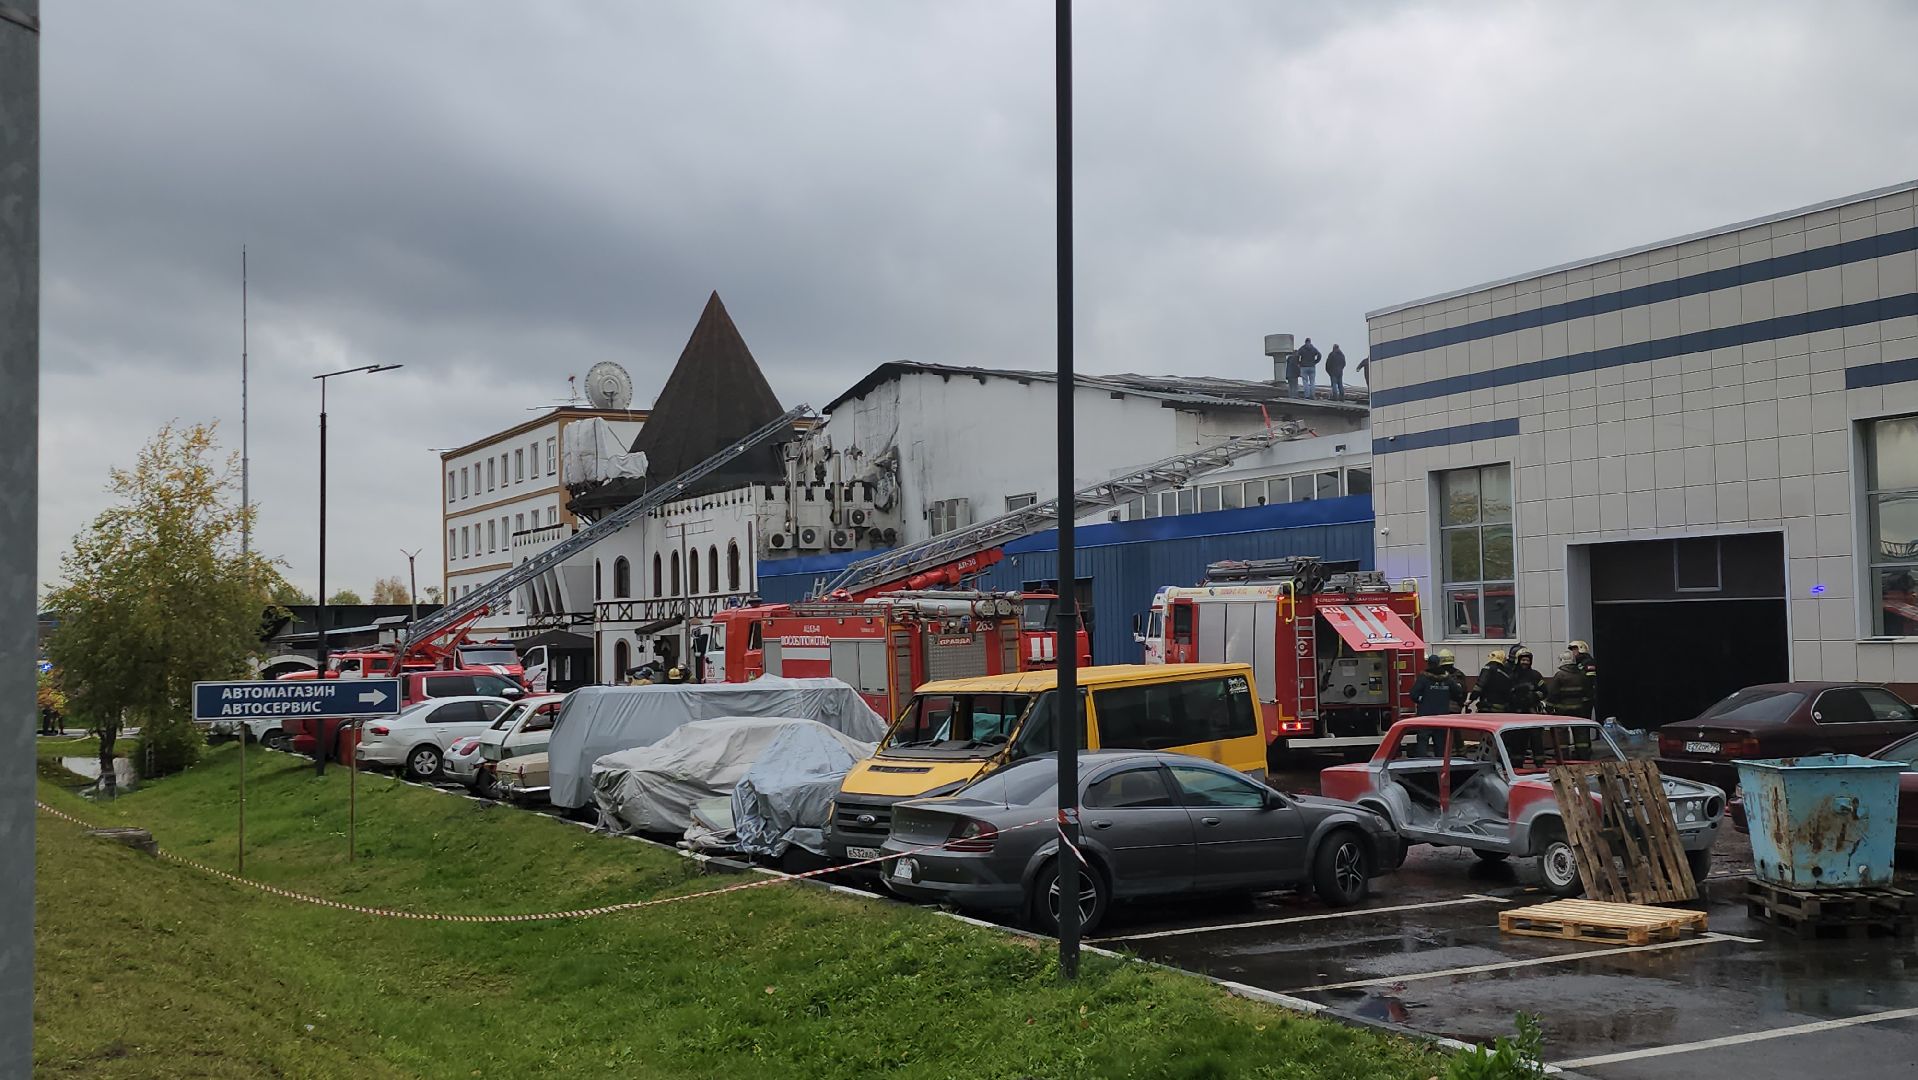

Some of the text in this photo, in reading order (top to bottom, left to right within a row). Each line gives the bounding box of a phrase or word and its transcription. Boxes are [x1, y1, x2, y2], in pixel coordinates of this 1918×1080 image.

[976, 621, 994, 632] 263
[221, 685, 336, 700] АВТОМАГАЗИН
[221, 701, 322, 715] АВТОСЕРВИС
